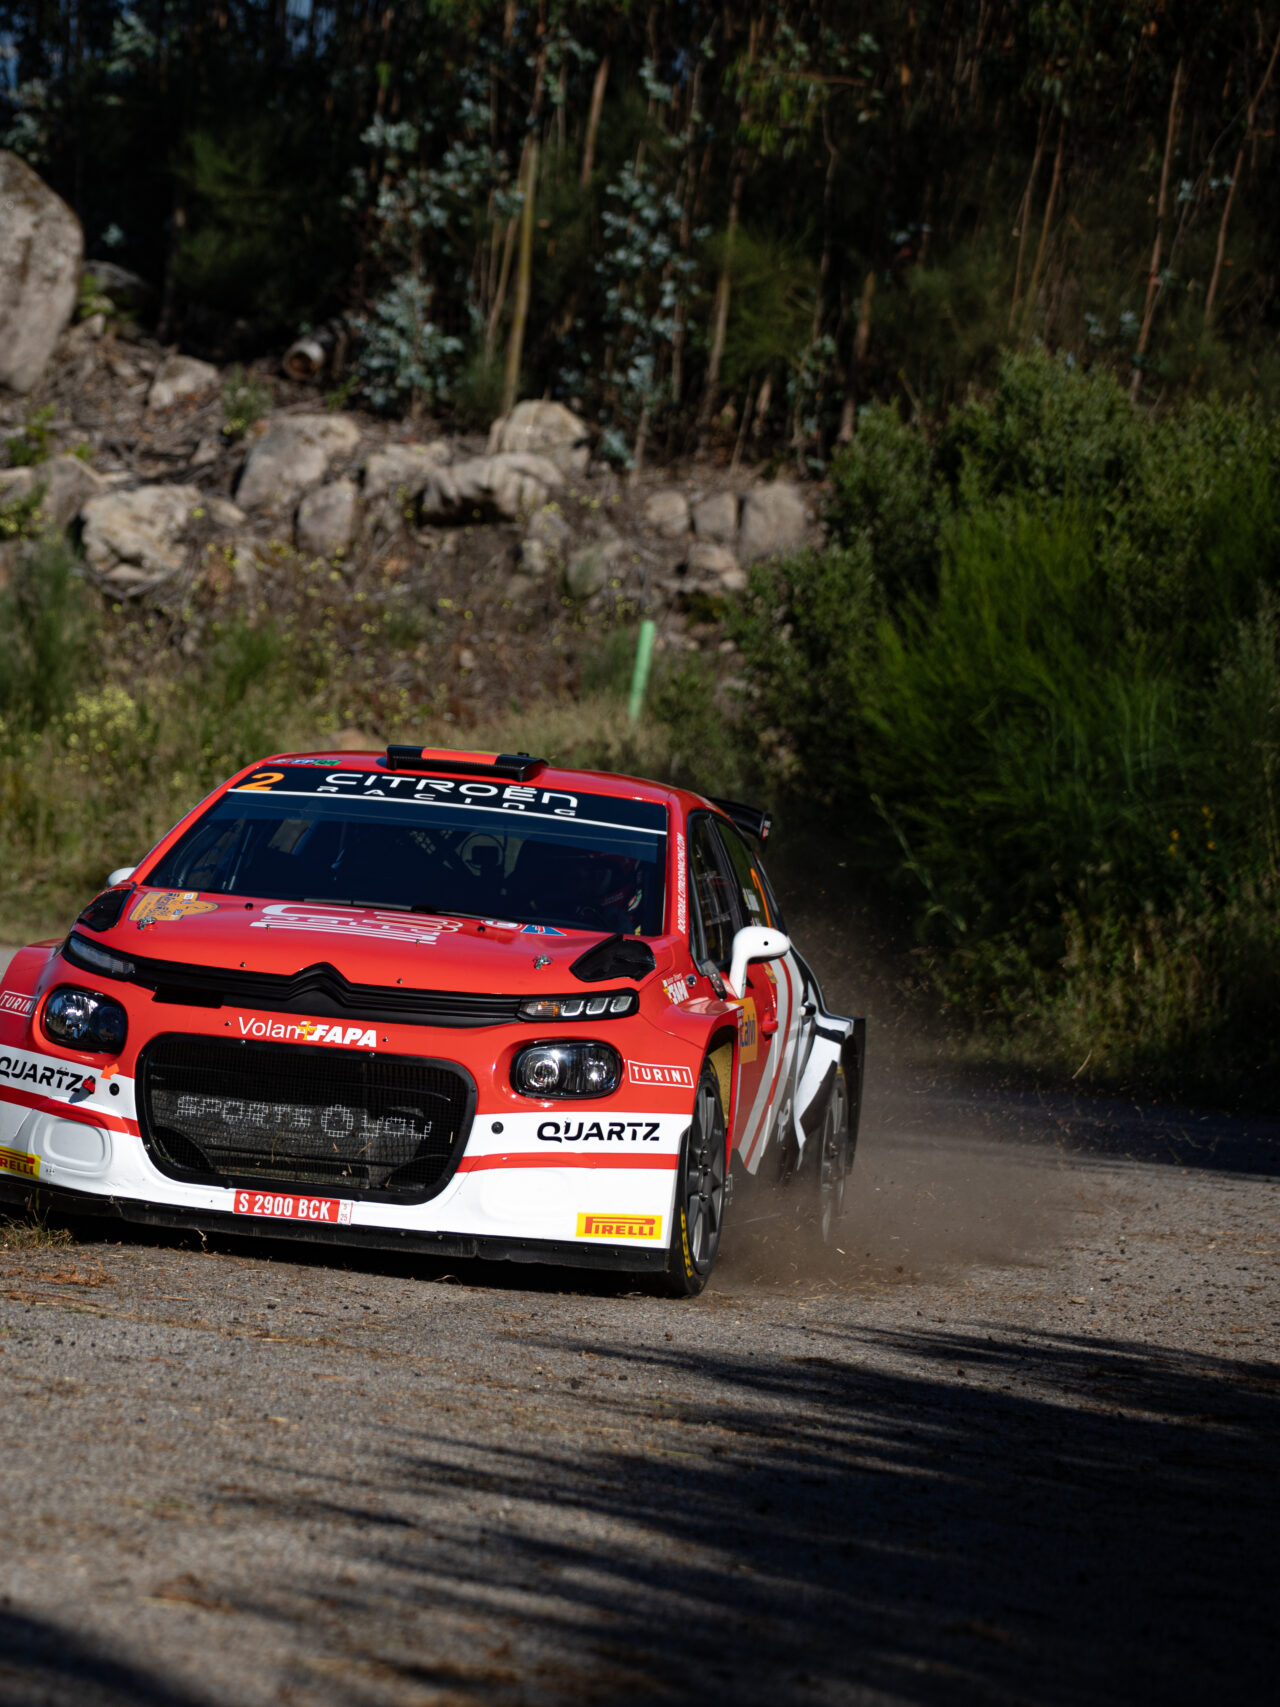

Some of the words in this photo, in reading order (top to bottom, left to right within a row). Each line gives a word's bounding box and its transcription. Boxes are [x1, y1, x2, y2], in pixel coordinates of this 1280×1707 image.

[236, 772, 285, 791] 2
[325, 773, 578, 807] CITROËN
[307, 1024, 377, 1047] FAPA
[633, 1066, 689, 1083] TURINI
[536, 1121, 660, 1144] QUARTZ
[239, 1193, 249, 1212] S
[253, 1195, 294, 1216] 2900
[297, 1199, 332, 1220] BCK
[584, 1216, 656, 1236] PIRELLI
